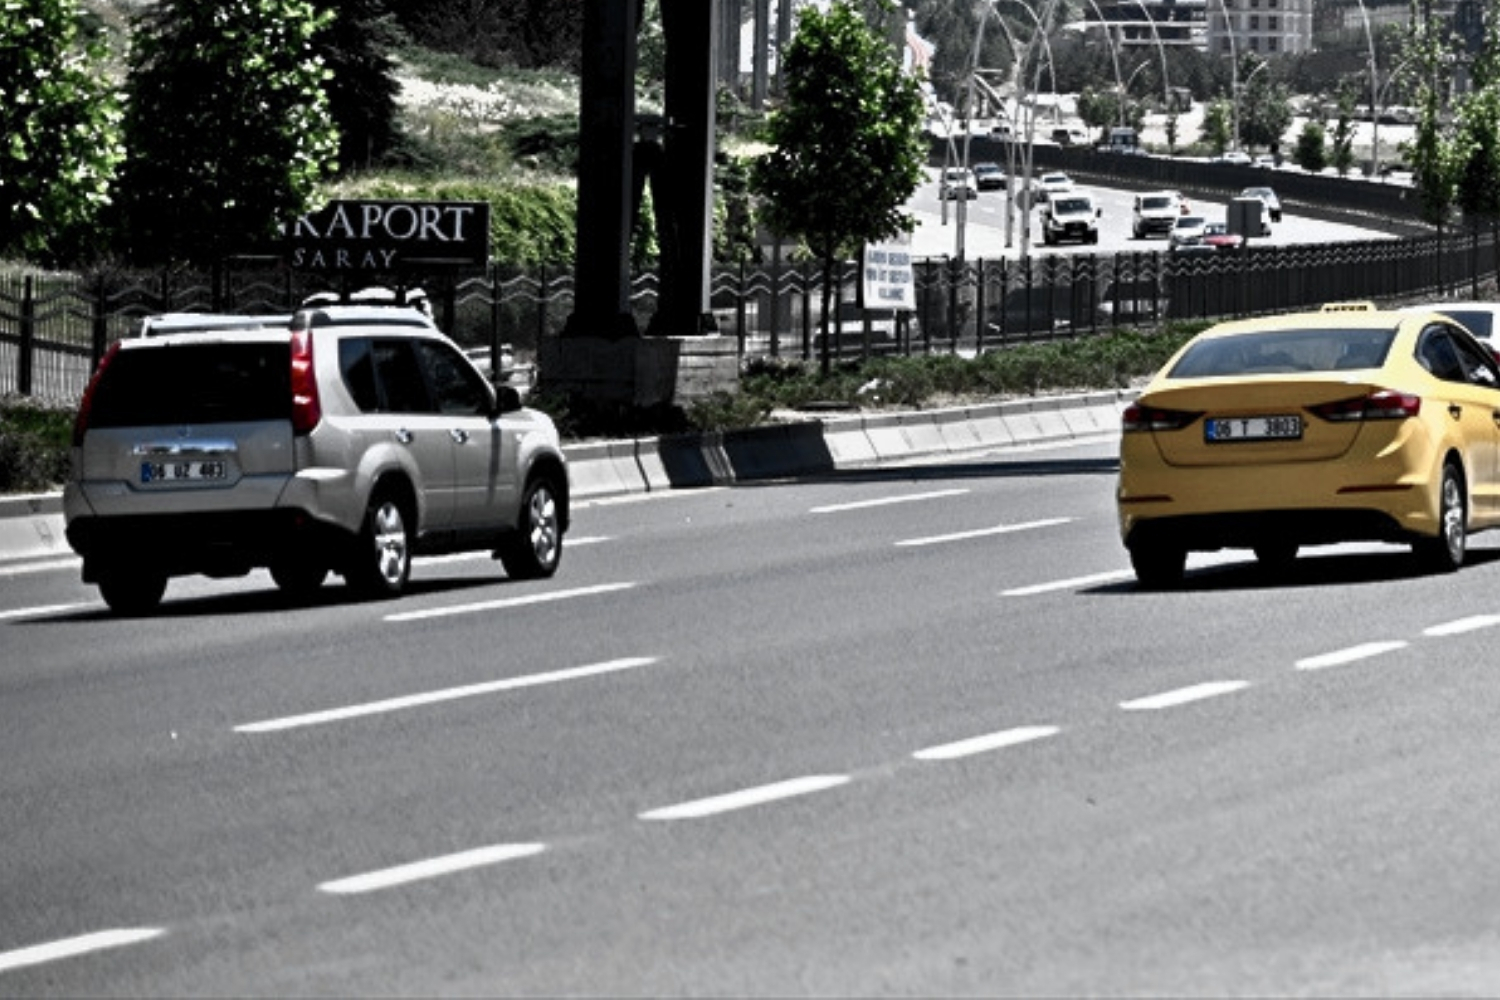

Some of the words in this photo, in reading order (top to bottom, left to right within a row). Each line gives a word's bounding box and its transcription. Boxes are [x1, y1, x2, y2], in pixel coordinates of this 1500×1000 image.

[277, 203, 475, 241] KAPORT
[292, 248, 396, 268] SARAY
[1241, 420, 1249, 437] T
